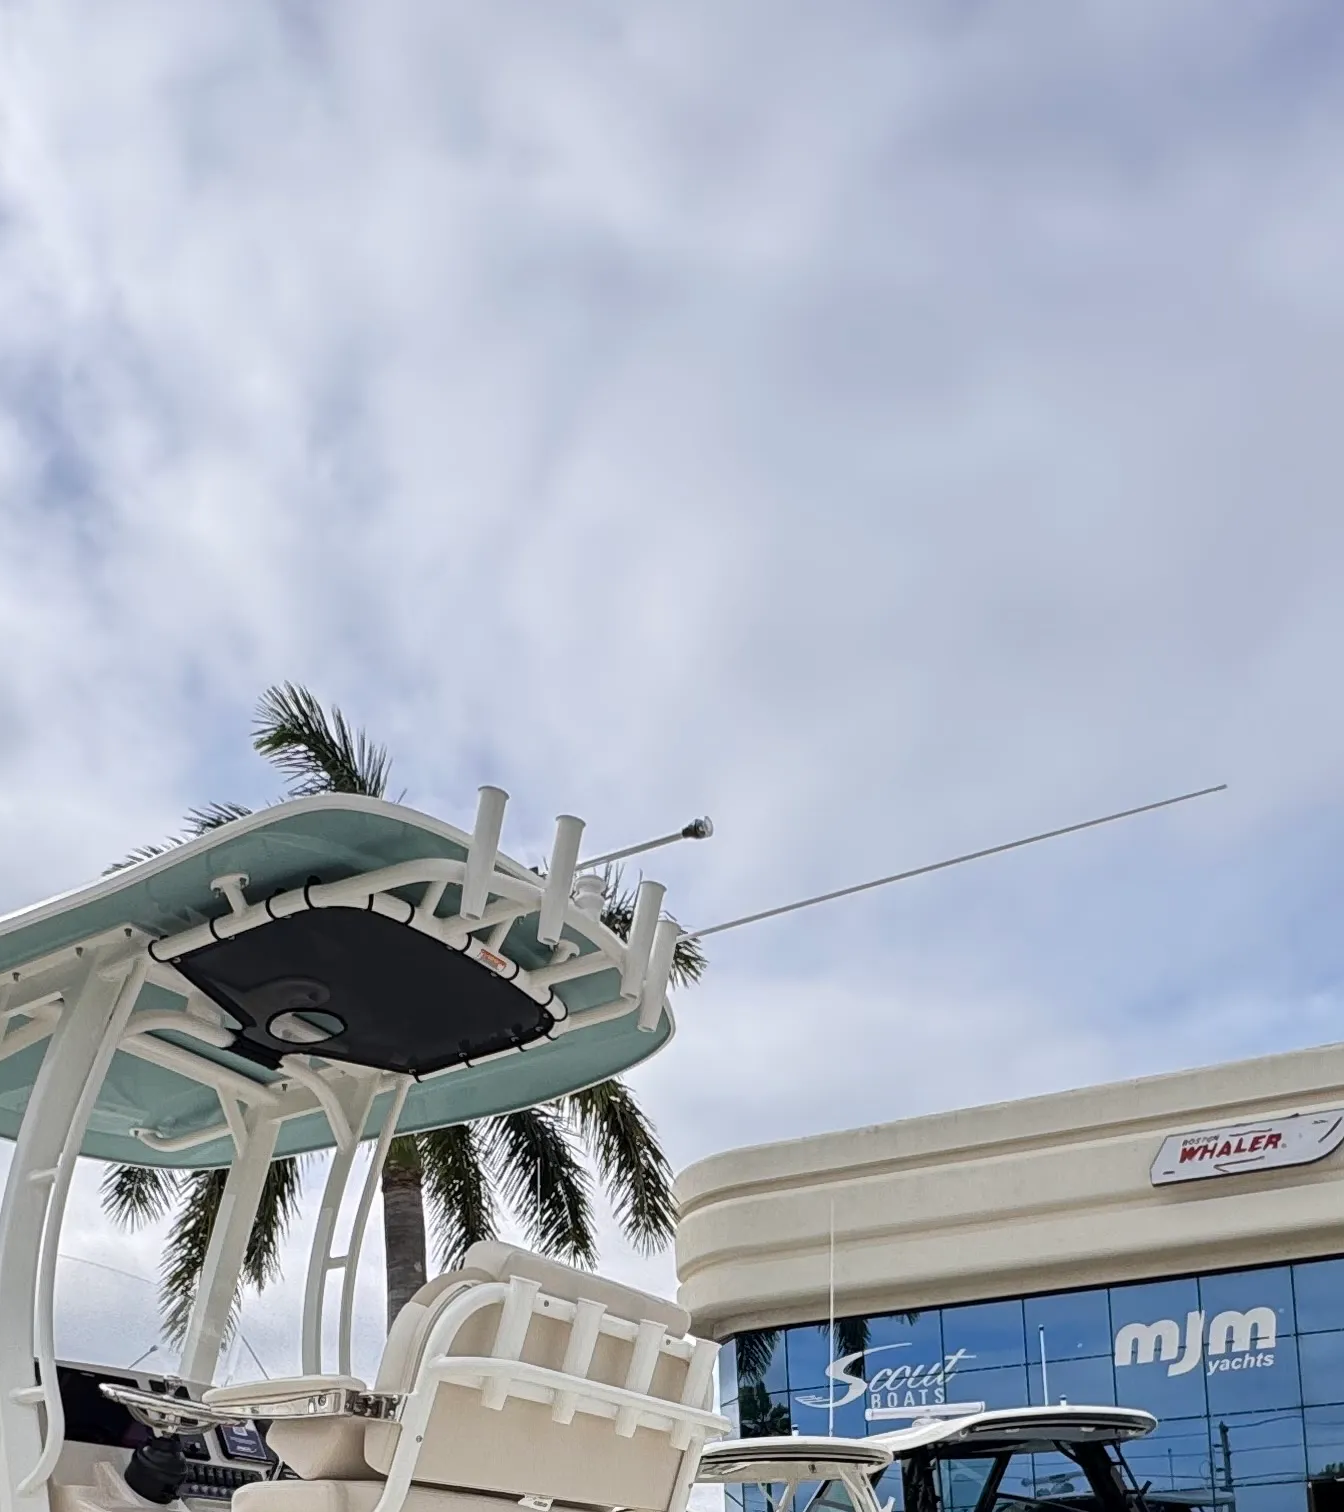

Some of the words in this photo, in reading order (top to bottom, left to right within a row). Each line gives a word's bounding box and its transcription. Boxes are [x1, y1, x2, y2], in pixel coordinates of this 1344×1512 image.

[1179, 1133, 1282, 1164] WHALER
[1182, 1134, 1220, 1146] BOSTON
[795, 1342, 977, 1409] Scout
[1206, 1352, 1275, 1377] yachts
[871, 1388, 946, 1409] BOATS
